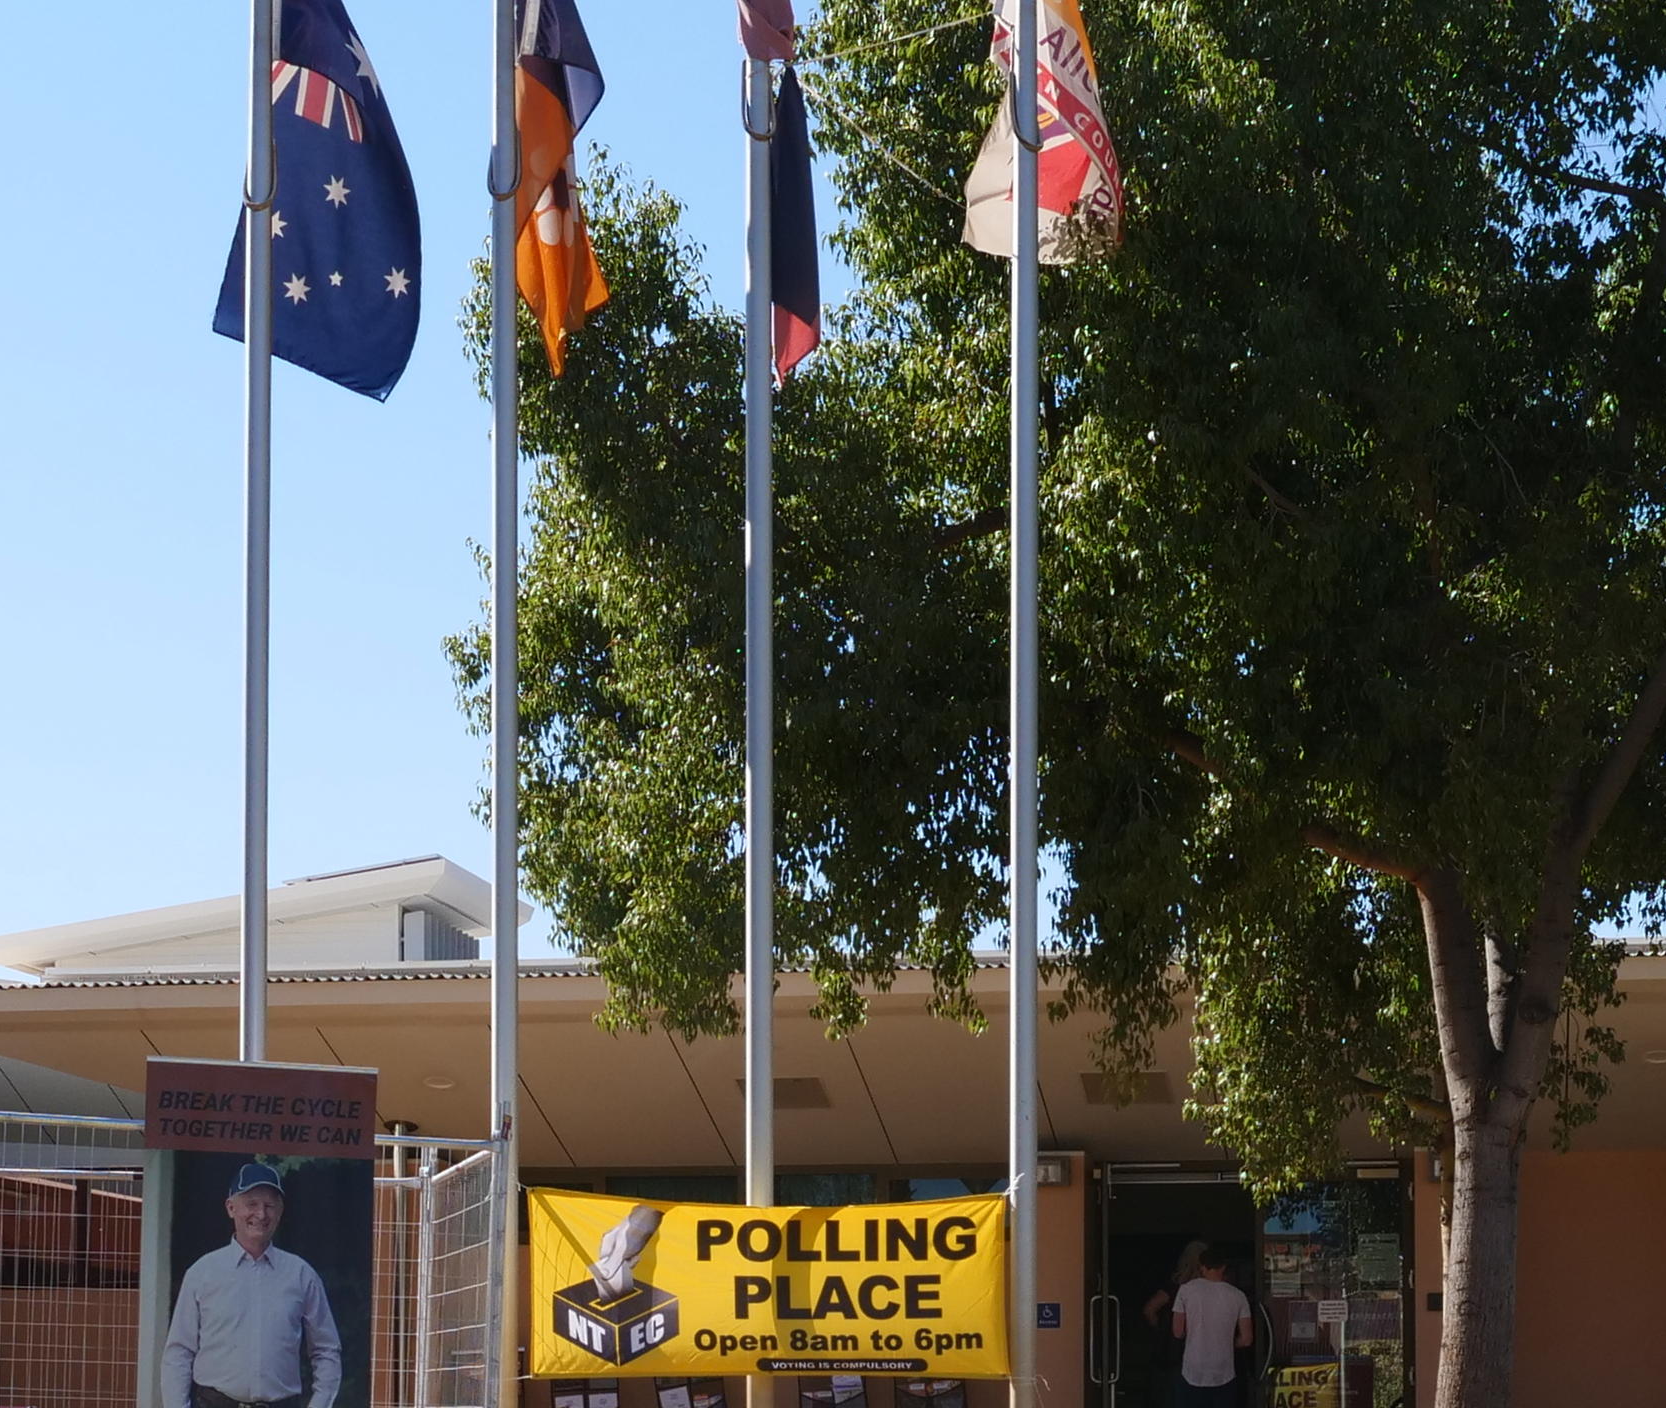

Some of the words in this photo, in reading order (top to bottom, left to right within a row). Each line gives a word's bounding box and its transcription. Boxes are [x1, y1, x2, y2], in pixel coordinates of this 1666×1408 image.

[159, 1091, 236, 1112] BREAK
[241, 1095, 285, 1115] THE
[291, 1098, 362, 1120] CYCLE
[159, 1118, 273, 1140] TOGETHER
[280, 1124, 312, 1142] WE
[317, 1126, 362, 1145] CAN
[696, 1216, 977, 1262] POLLING
[734, 1274, 943, 1320] PLACE
[694, 1329, 778, 1356] Open
[790, 1329, 858, 1351] 8am
[870, 1330, 903, 1351] to
[914, 1328, 983, 1355] 6pm
[771, 1361, 815, 1370] VOTING
[819, 1362, 830, 1370] IS
[833, 1361, 913, 1370] COMPULSORY
